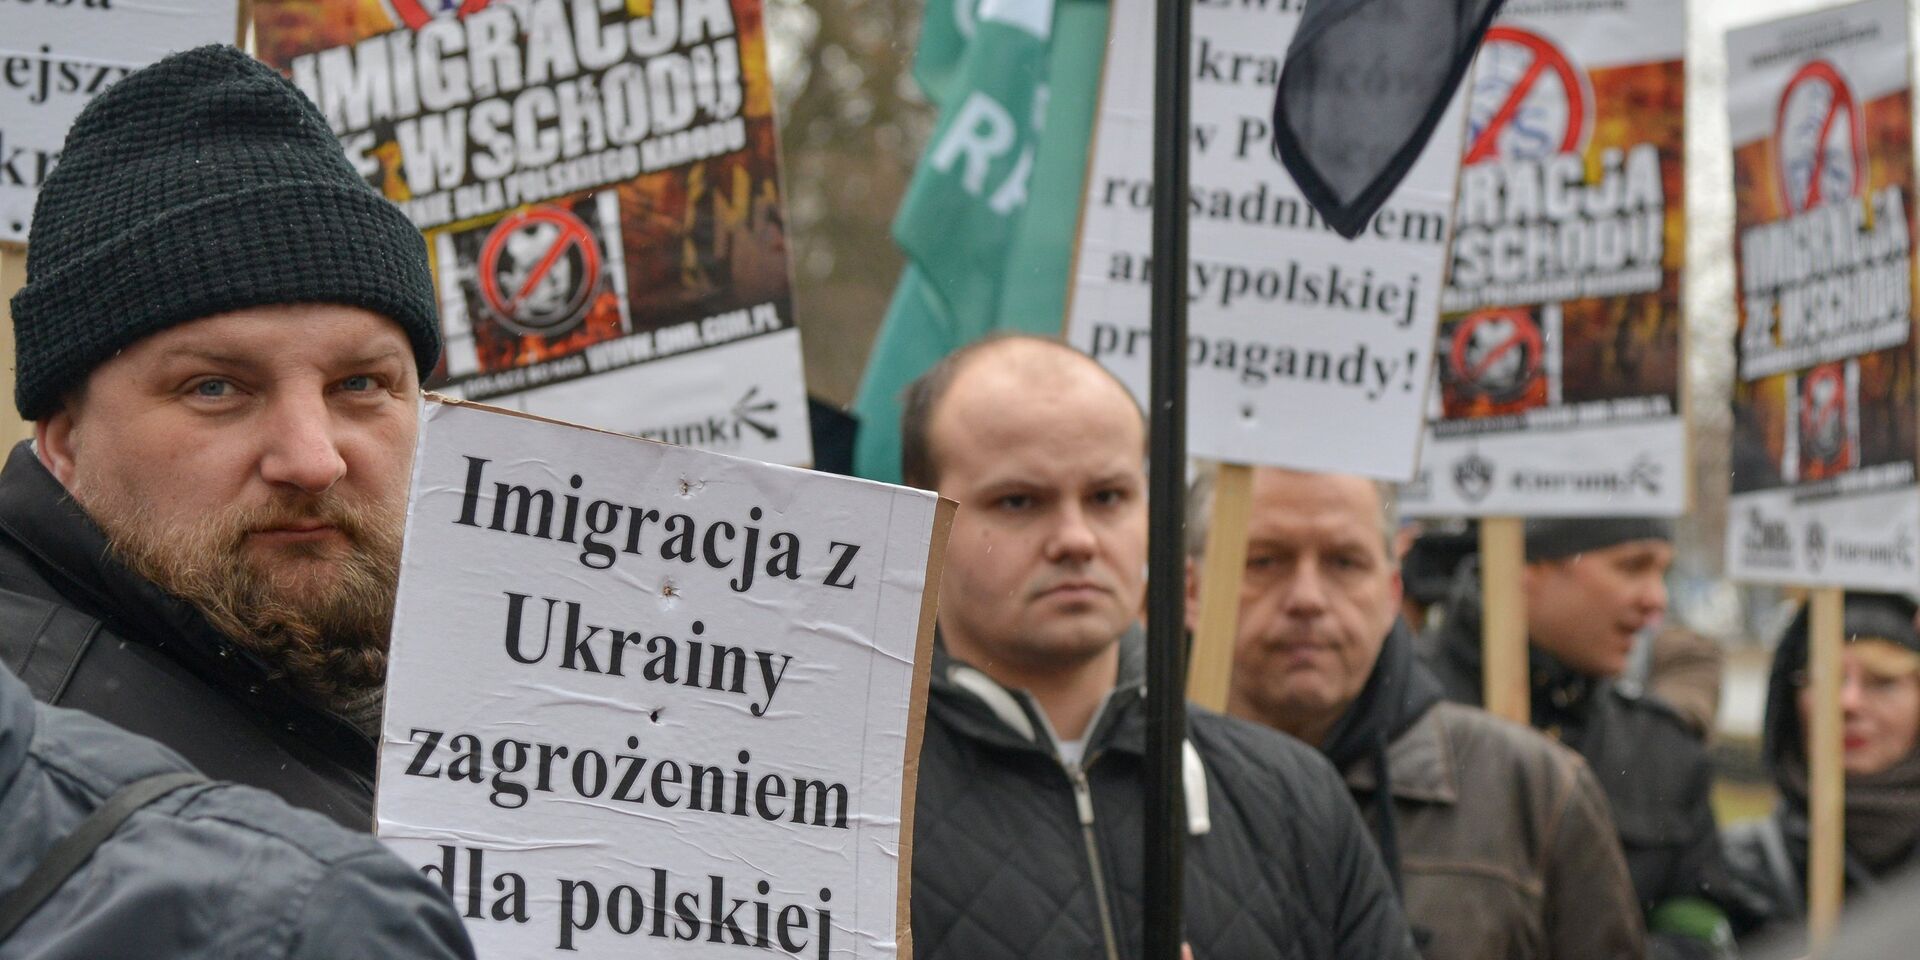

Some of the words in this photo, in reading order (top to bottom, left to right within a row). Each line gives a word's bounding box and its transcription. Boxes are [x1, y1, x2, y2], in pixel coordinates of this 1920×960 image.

[4, 45, 129, 103] ejsz
[1109, 252, 1419, 327] aypolskiej
[1090, 320, 1418, 401] prpagandy!
[453, 455, 801, 592] Imigracja
[823, 541, 861, 590] z
[503, 591, 793, 717] Ukrainy
[405, 727, 850, 829] zagrożeniem
[419, 844, 531, 924] dla
[556, 867, 833, 960] polskiej
